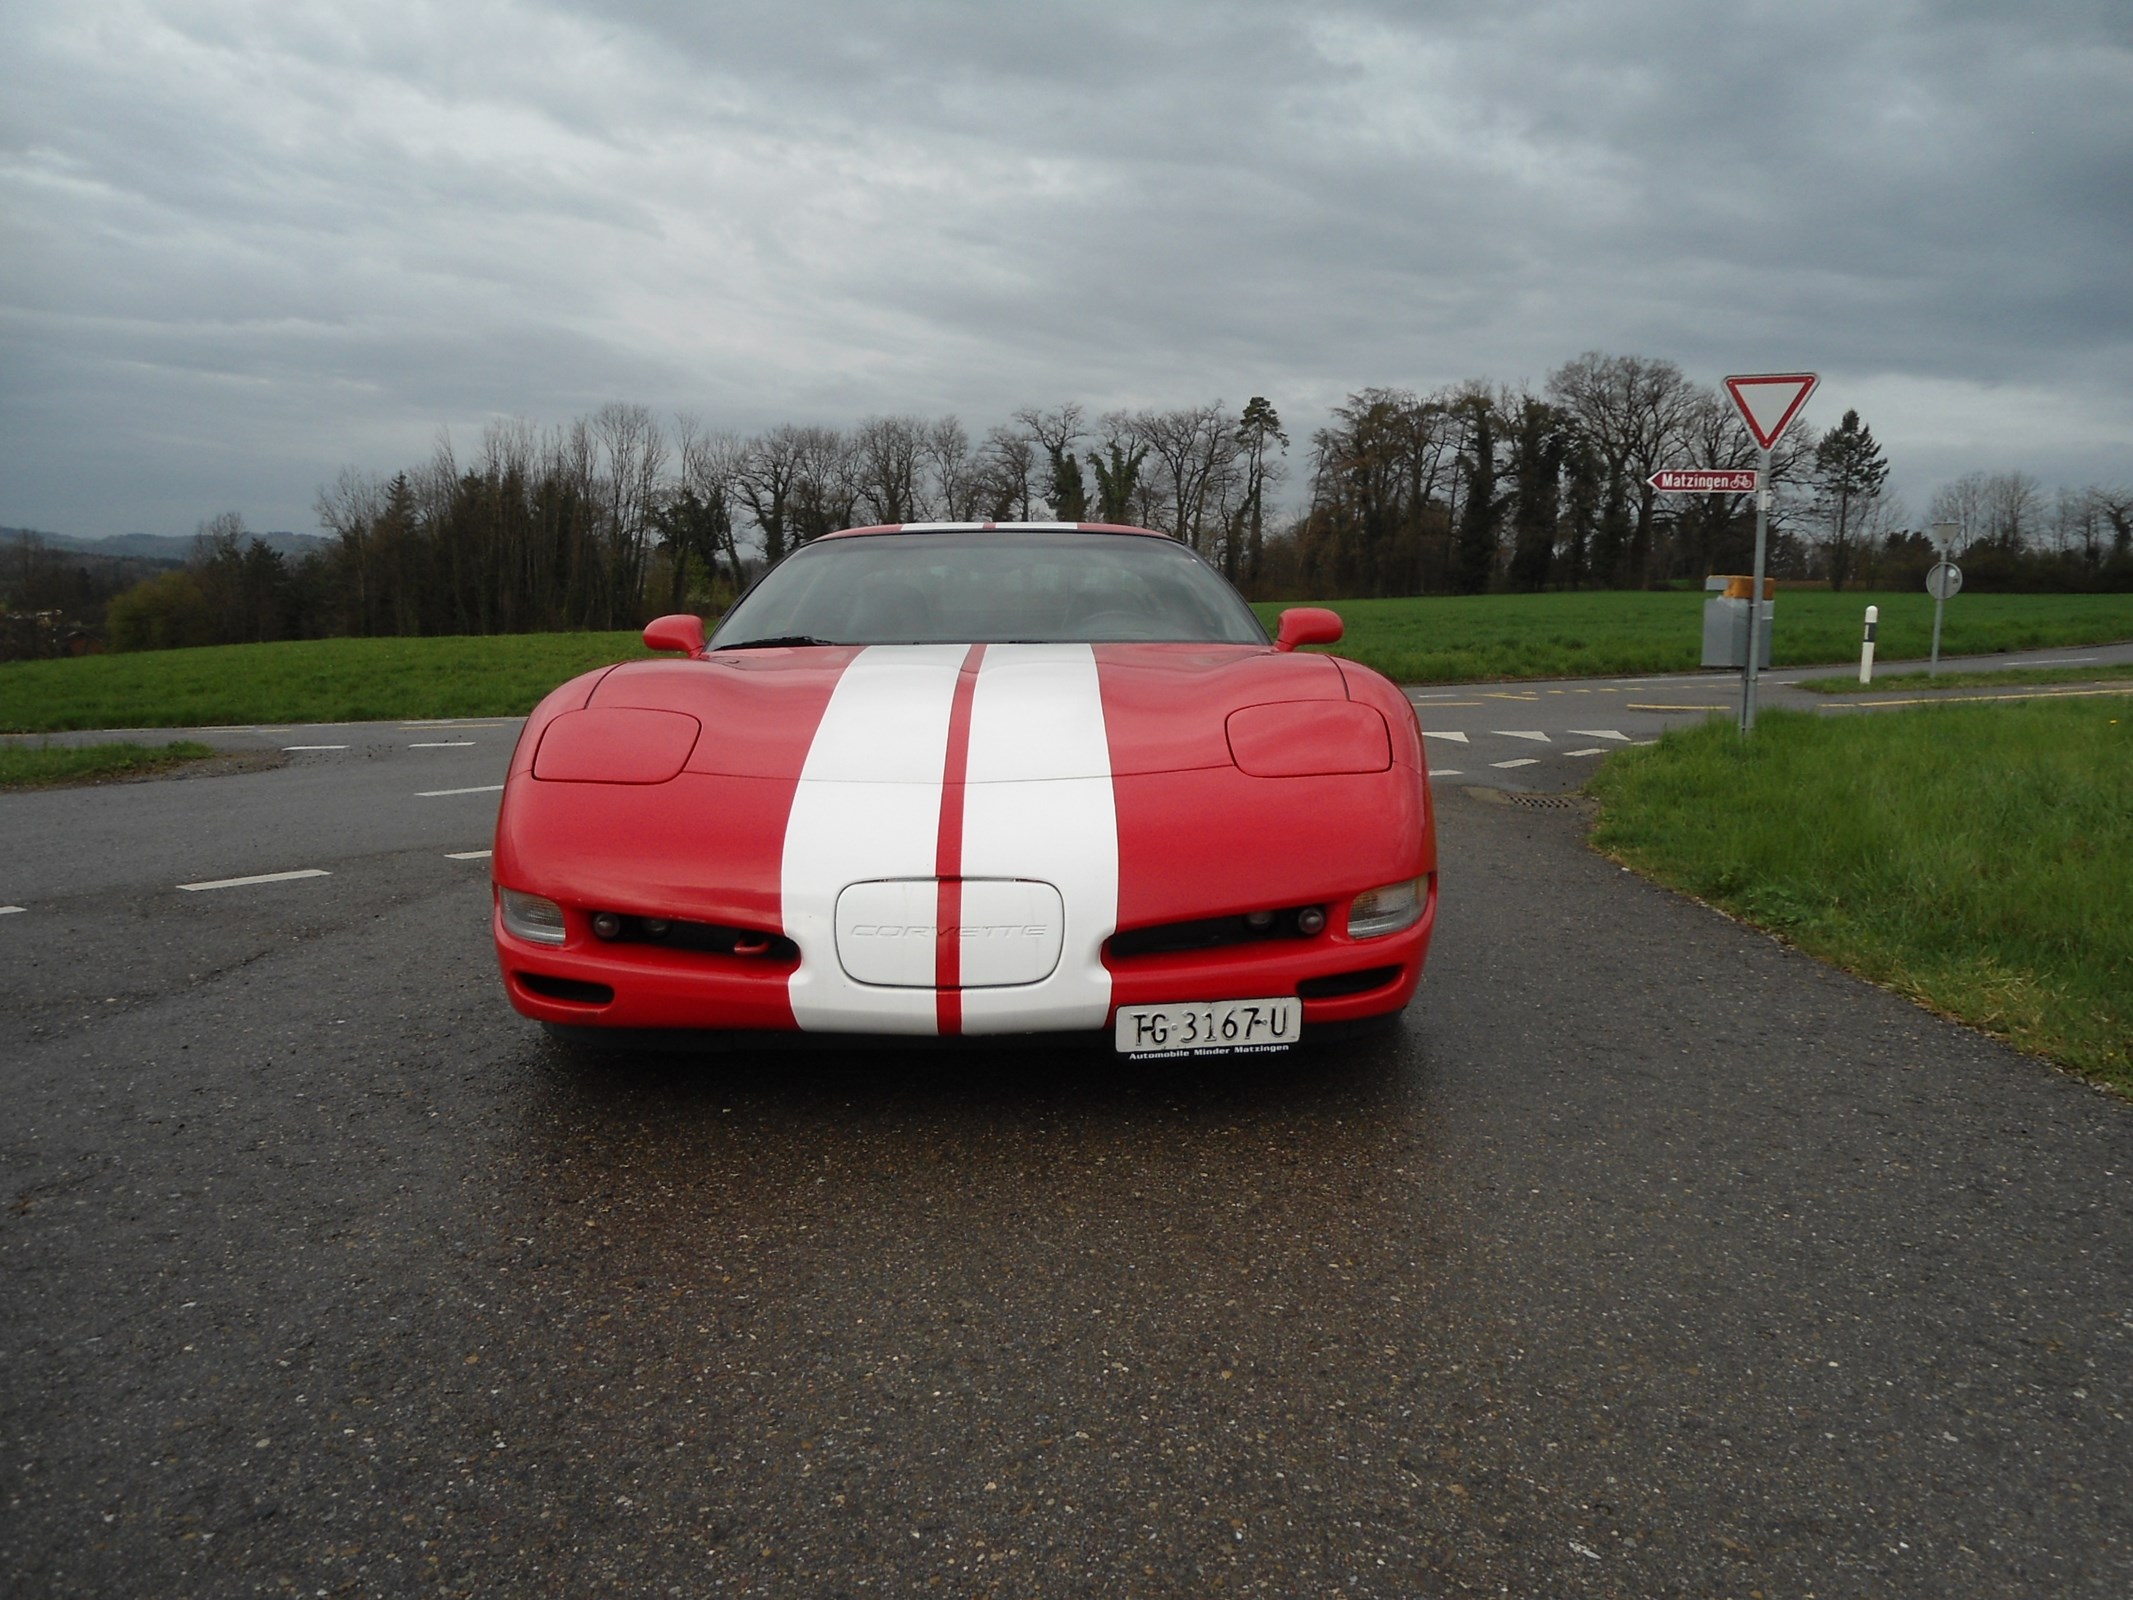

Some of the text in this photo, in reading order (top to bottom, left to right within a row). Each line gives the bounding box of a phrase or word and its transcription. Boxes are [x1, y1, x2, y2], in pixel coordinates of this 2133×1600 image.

[1662, 473, 1728, 490] Matzingen
[850, 924, 1047, 937] CORVETTE
[1129, 1044, 1289, 1060] Automobile Minder Matzingen
